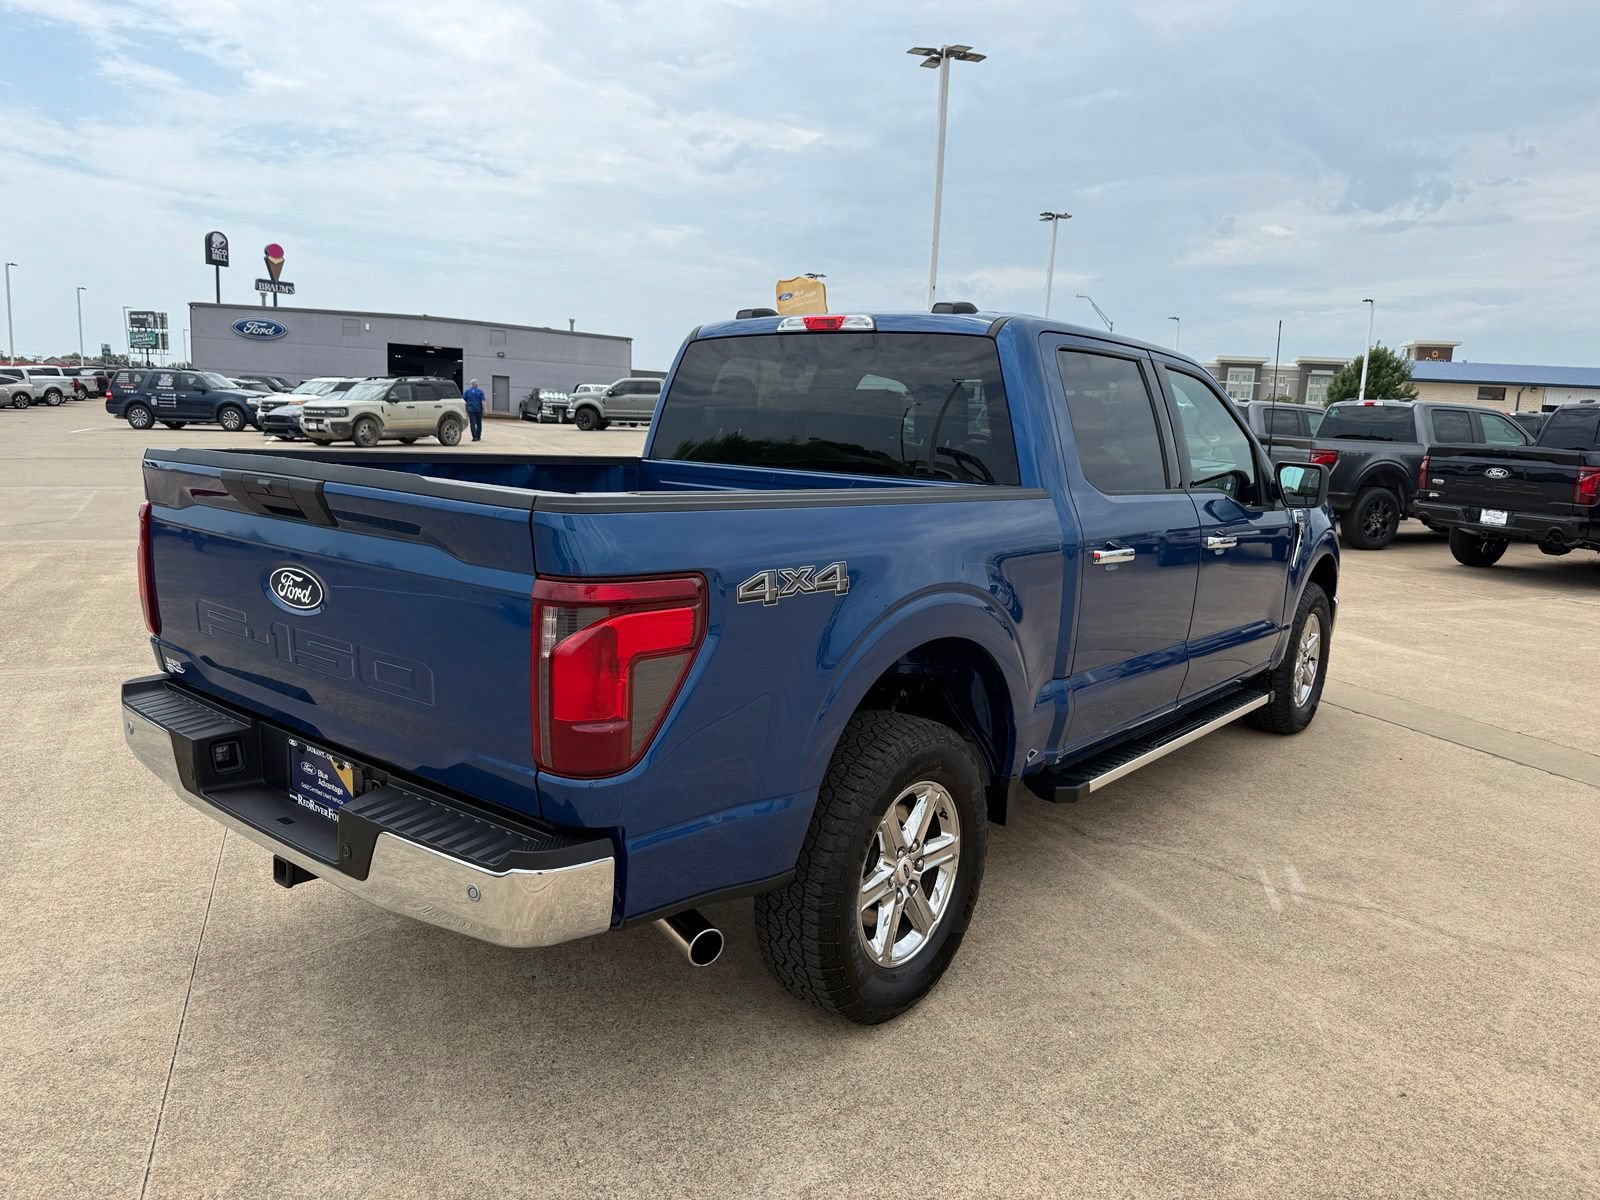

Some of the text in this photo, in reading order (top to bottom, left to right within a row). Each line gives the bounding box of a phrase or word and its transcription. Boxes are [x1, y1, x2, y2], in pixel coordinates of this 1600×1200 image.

[211, 248, 228, 256] TACO
[212, 254, 228, 262] BELL
[258, 282, 295, 294] BRAUM'S
[244, 322, 275, 335] Ford
[278, 572, 312, 604] Ford
[196, 598, 434, 708] F-150
[318, 770, 328, 780] Blue
[318, 778, 343, 794] Advantage
